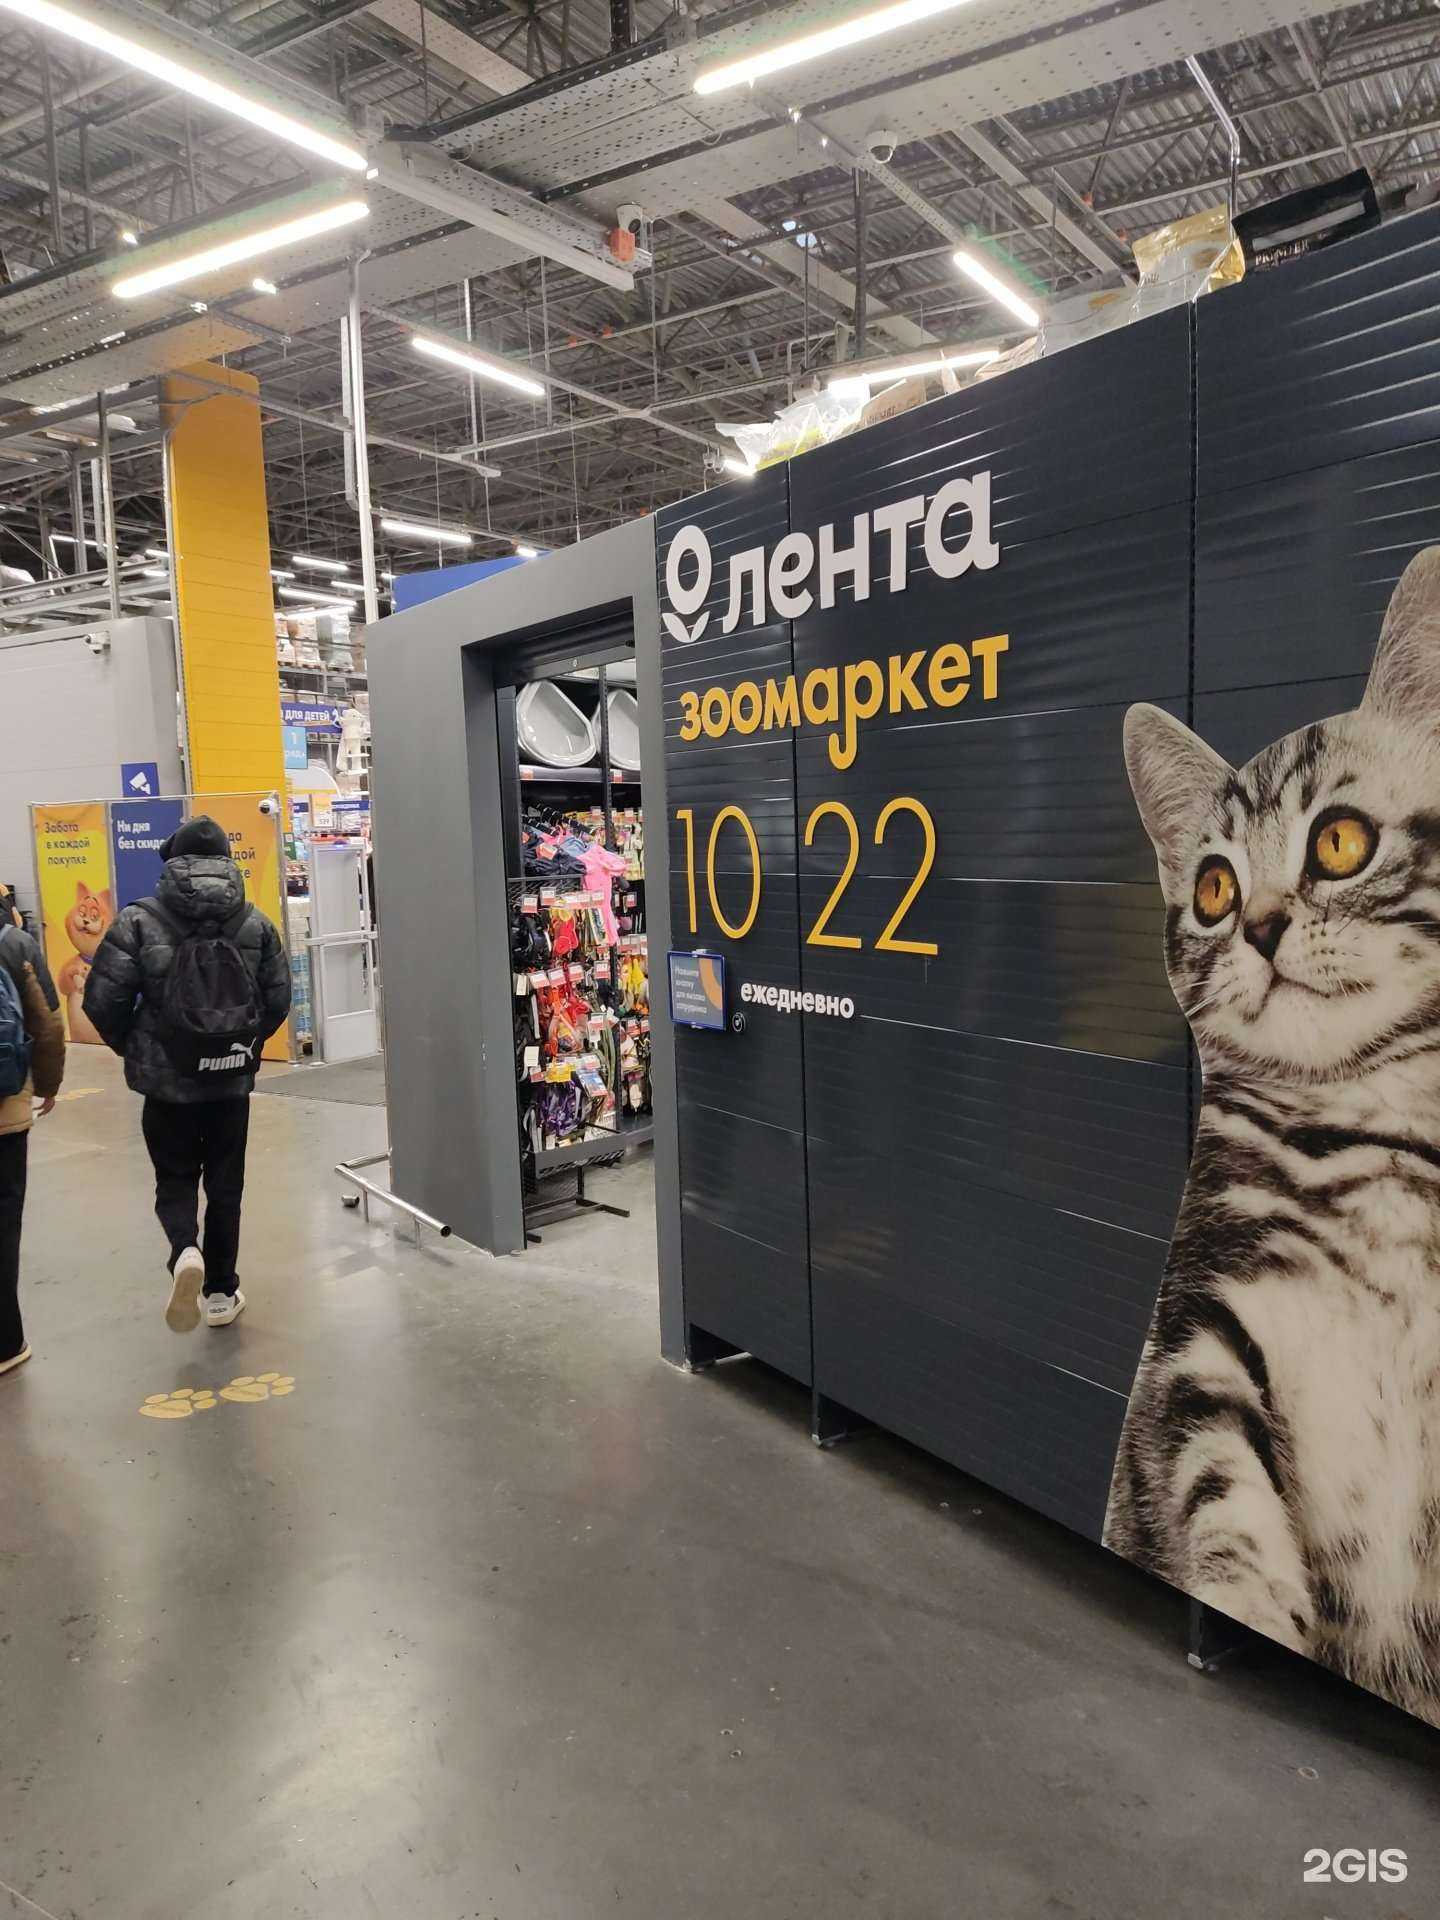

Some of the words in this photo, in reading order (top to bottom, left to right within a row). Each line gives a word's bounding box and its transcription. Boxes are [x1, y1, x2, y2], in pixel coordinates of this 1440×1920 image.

[722, 470, 999, 634] лента
[679, 634, 1009, 770] зоомаркет
[285, 710, 303, 720] ДЛЯ
[304, 710, 330, 721] ДЕТЕЙ
[45, 821, 80, 833] Забота
[117, 820, 131, 833] Ни
[132, 821, 151, 835] дня
[54, 837, 91, 850] каждой
[118, 836, 135, 850] без
[136, 838, 166, 851] скидо
[47, 856, 87, 868] покупке
[676, 805, 761, 939] 10
[804, 797, 938, 955] 22
[741, 982, 855, 1018] ежедневно
[198, 1053, 246, 1071] PUMA
